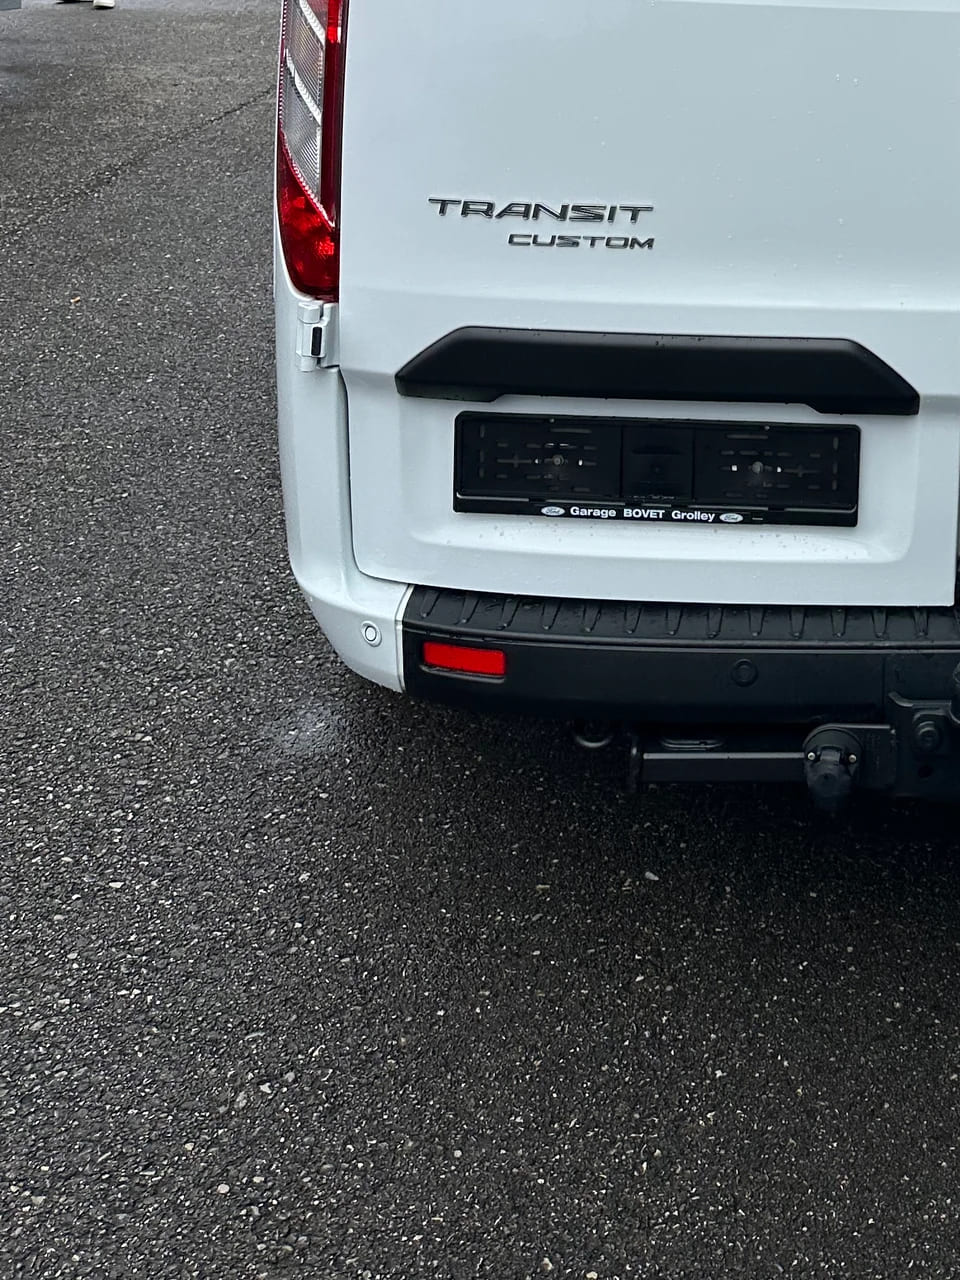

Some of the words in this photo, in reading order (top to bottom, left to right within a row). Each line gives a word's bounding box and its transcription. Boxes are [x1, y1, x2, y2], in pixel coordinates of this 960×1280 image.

[428, 197, 654, 223] TRANSIT
[508, 233, 655, 250] CUSTOM
[570, 506, 617, 519] Garage
[623, 508, 666, 519] BOVET
[671, 510, 716, 523] Grolley
